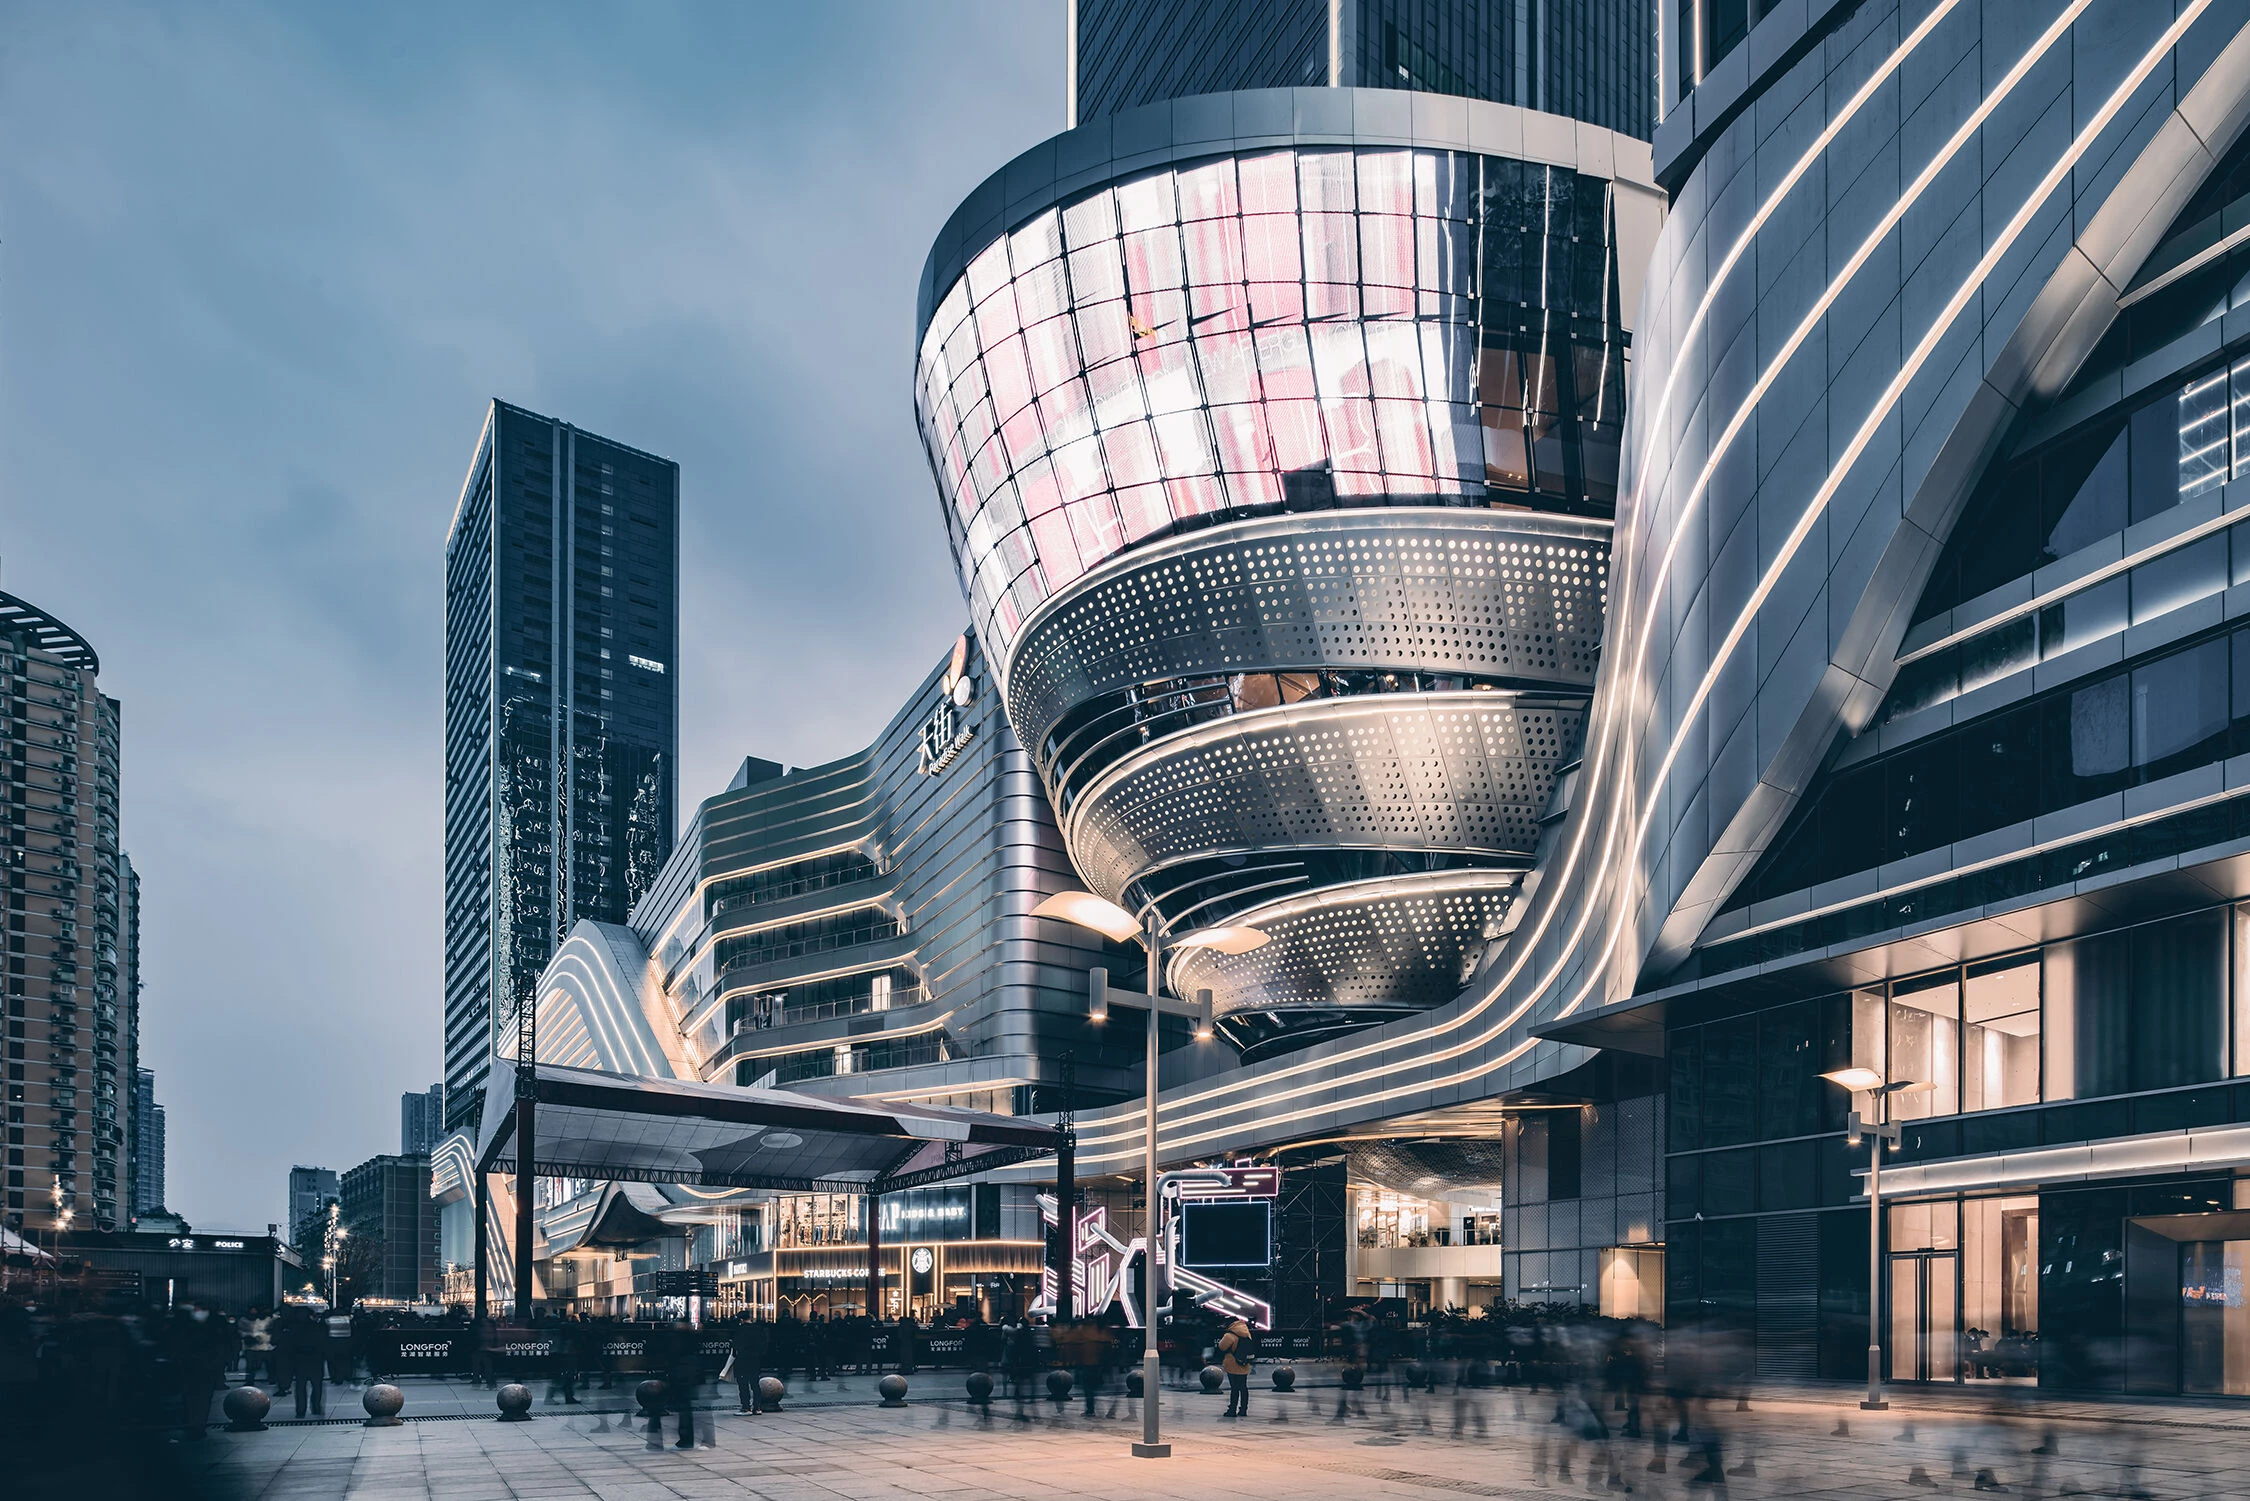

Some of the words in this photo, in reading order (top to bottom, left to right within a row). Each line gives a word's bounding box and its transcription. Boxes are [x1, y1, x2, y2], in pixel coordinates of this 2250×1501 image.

[917, 696, 954, 774] 天街
[928, 743, 956, 777] Paradise
[954, 724, 974, 750] Walk
[878, 1203, 900, 1230] AP
[937, 1206, 965, 1218] BABY
[168, 1238, 194, 1249] 公安
[803, 1268, 852, 1278] STARBUCKS
[853, 1267, 886, 1278] COFE
[400, 1343, 449, 1351] LONGFOR
